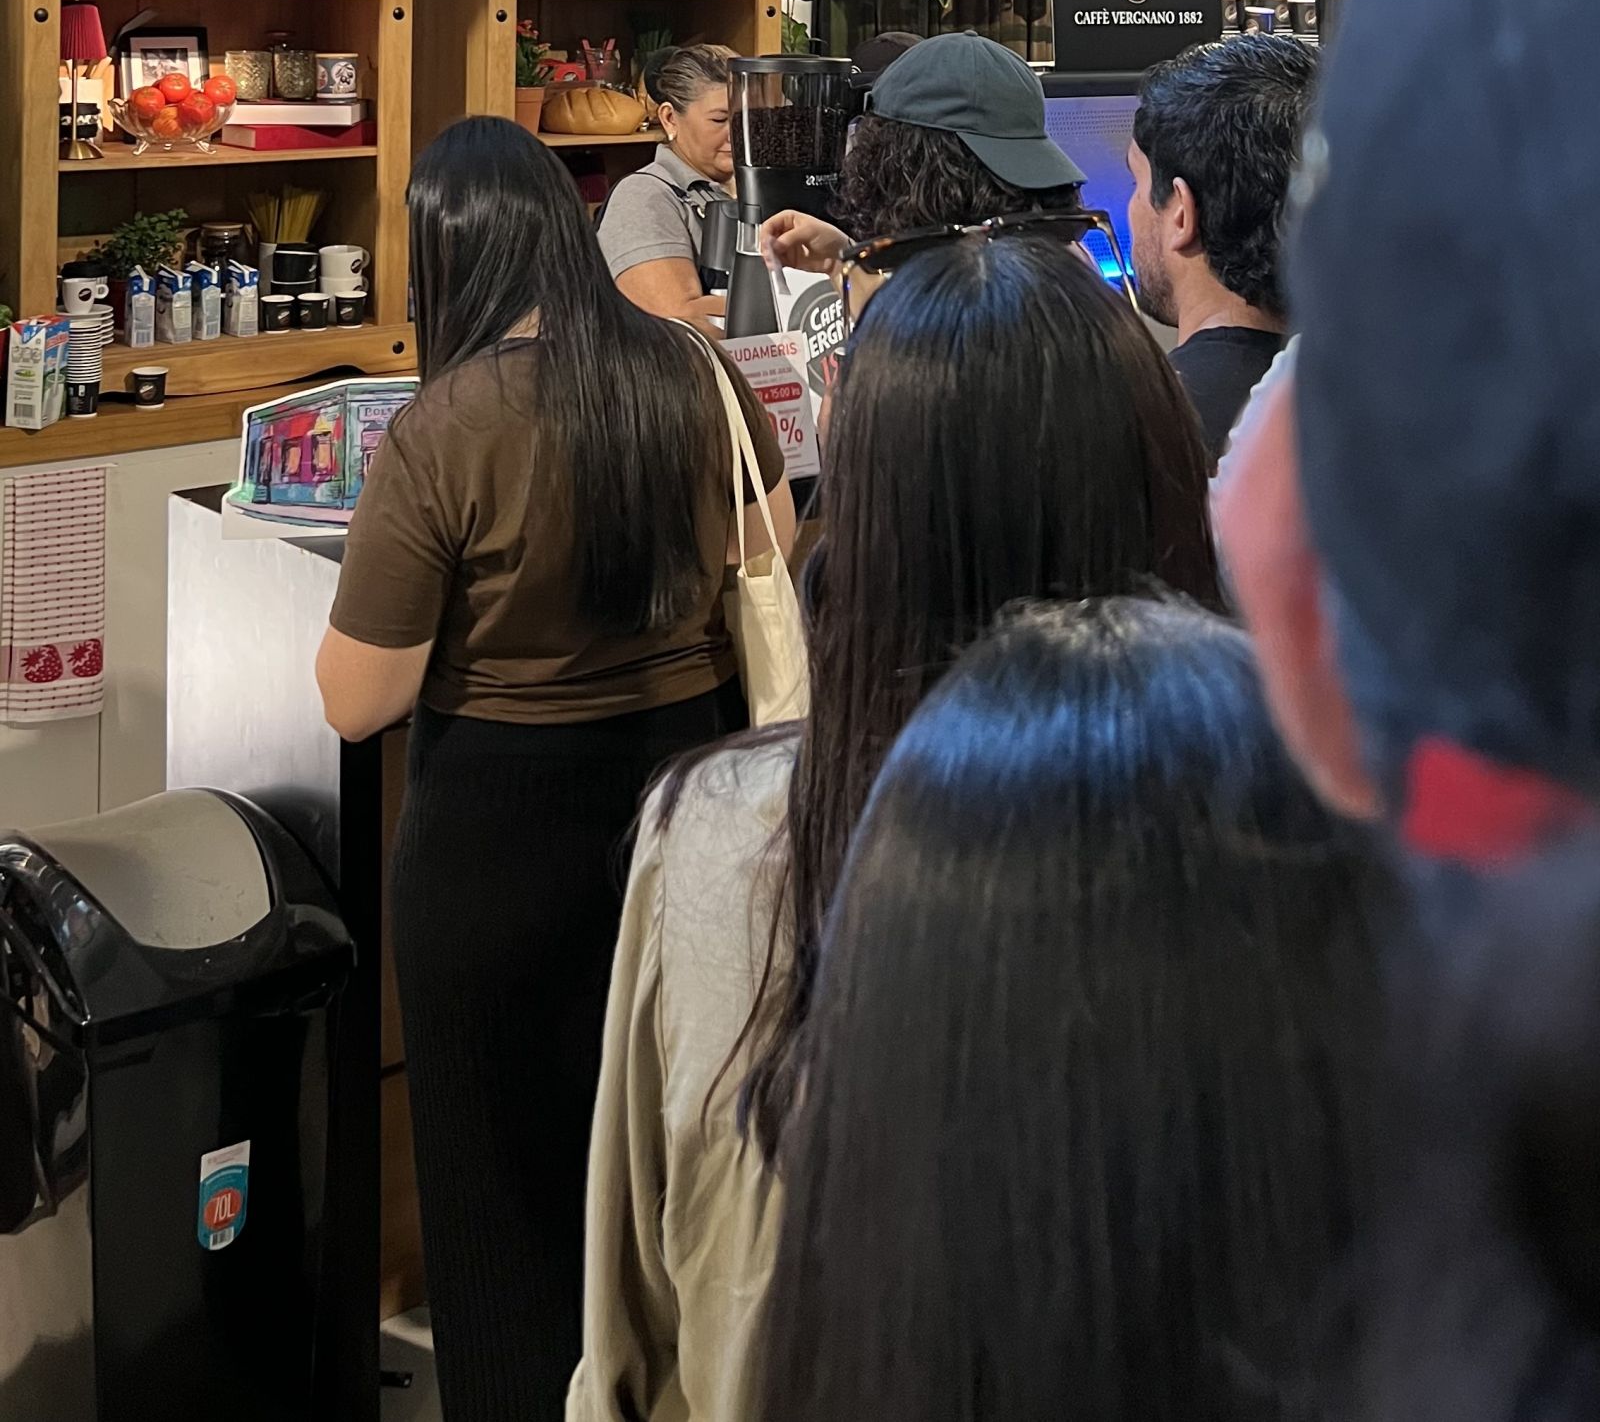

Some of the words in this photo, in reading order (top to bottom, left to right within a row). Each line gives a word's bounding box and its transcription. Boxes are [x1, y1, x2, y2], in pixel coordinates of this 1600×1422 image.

[1074, 8, 1110, 25] CAFFÈ
[1112, 11, 1175, 24] VERGNANO
[1178, 10, 1203, 24] 1882
[810, 298, 843, 331] CAFF
